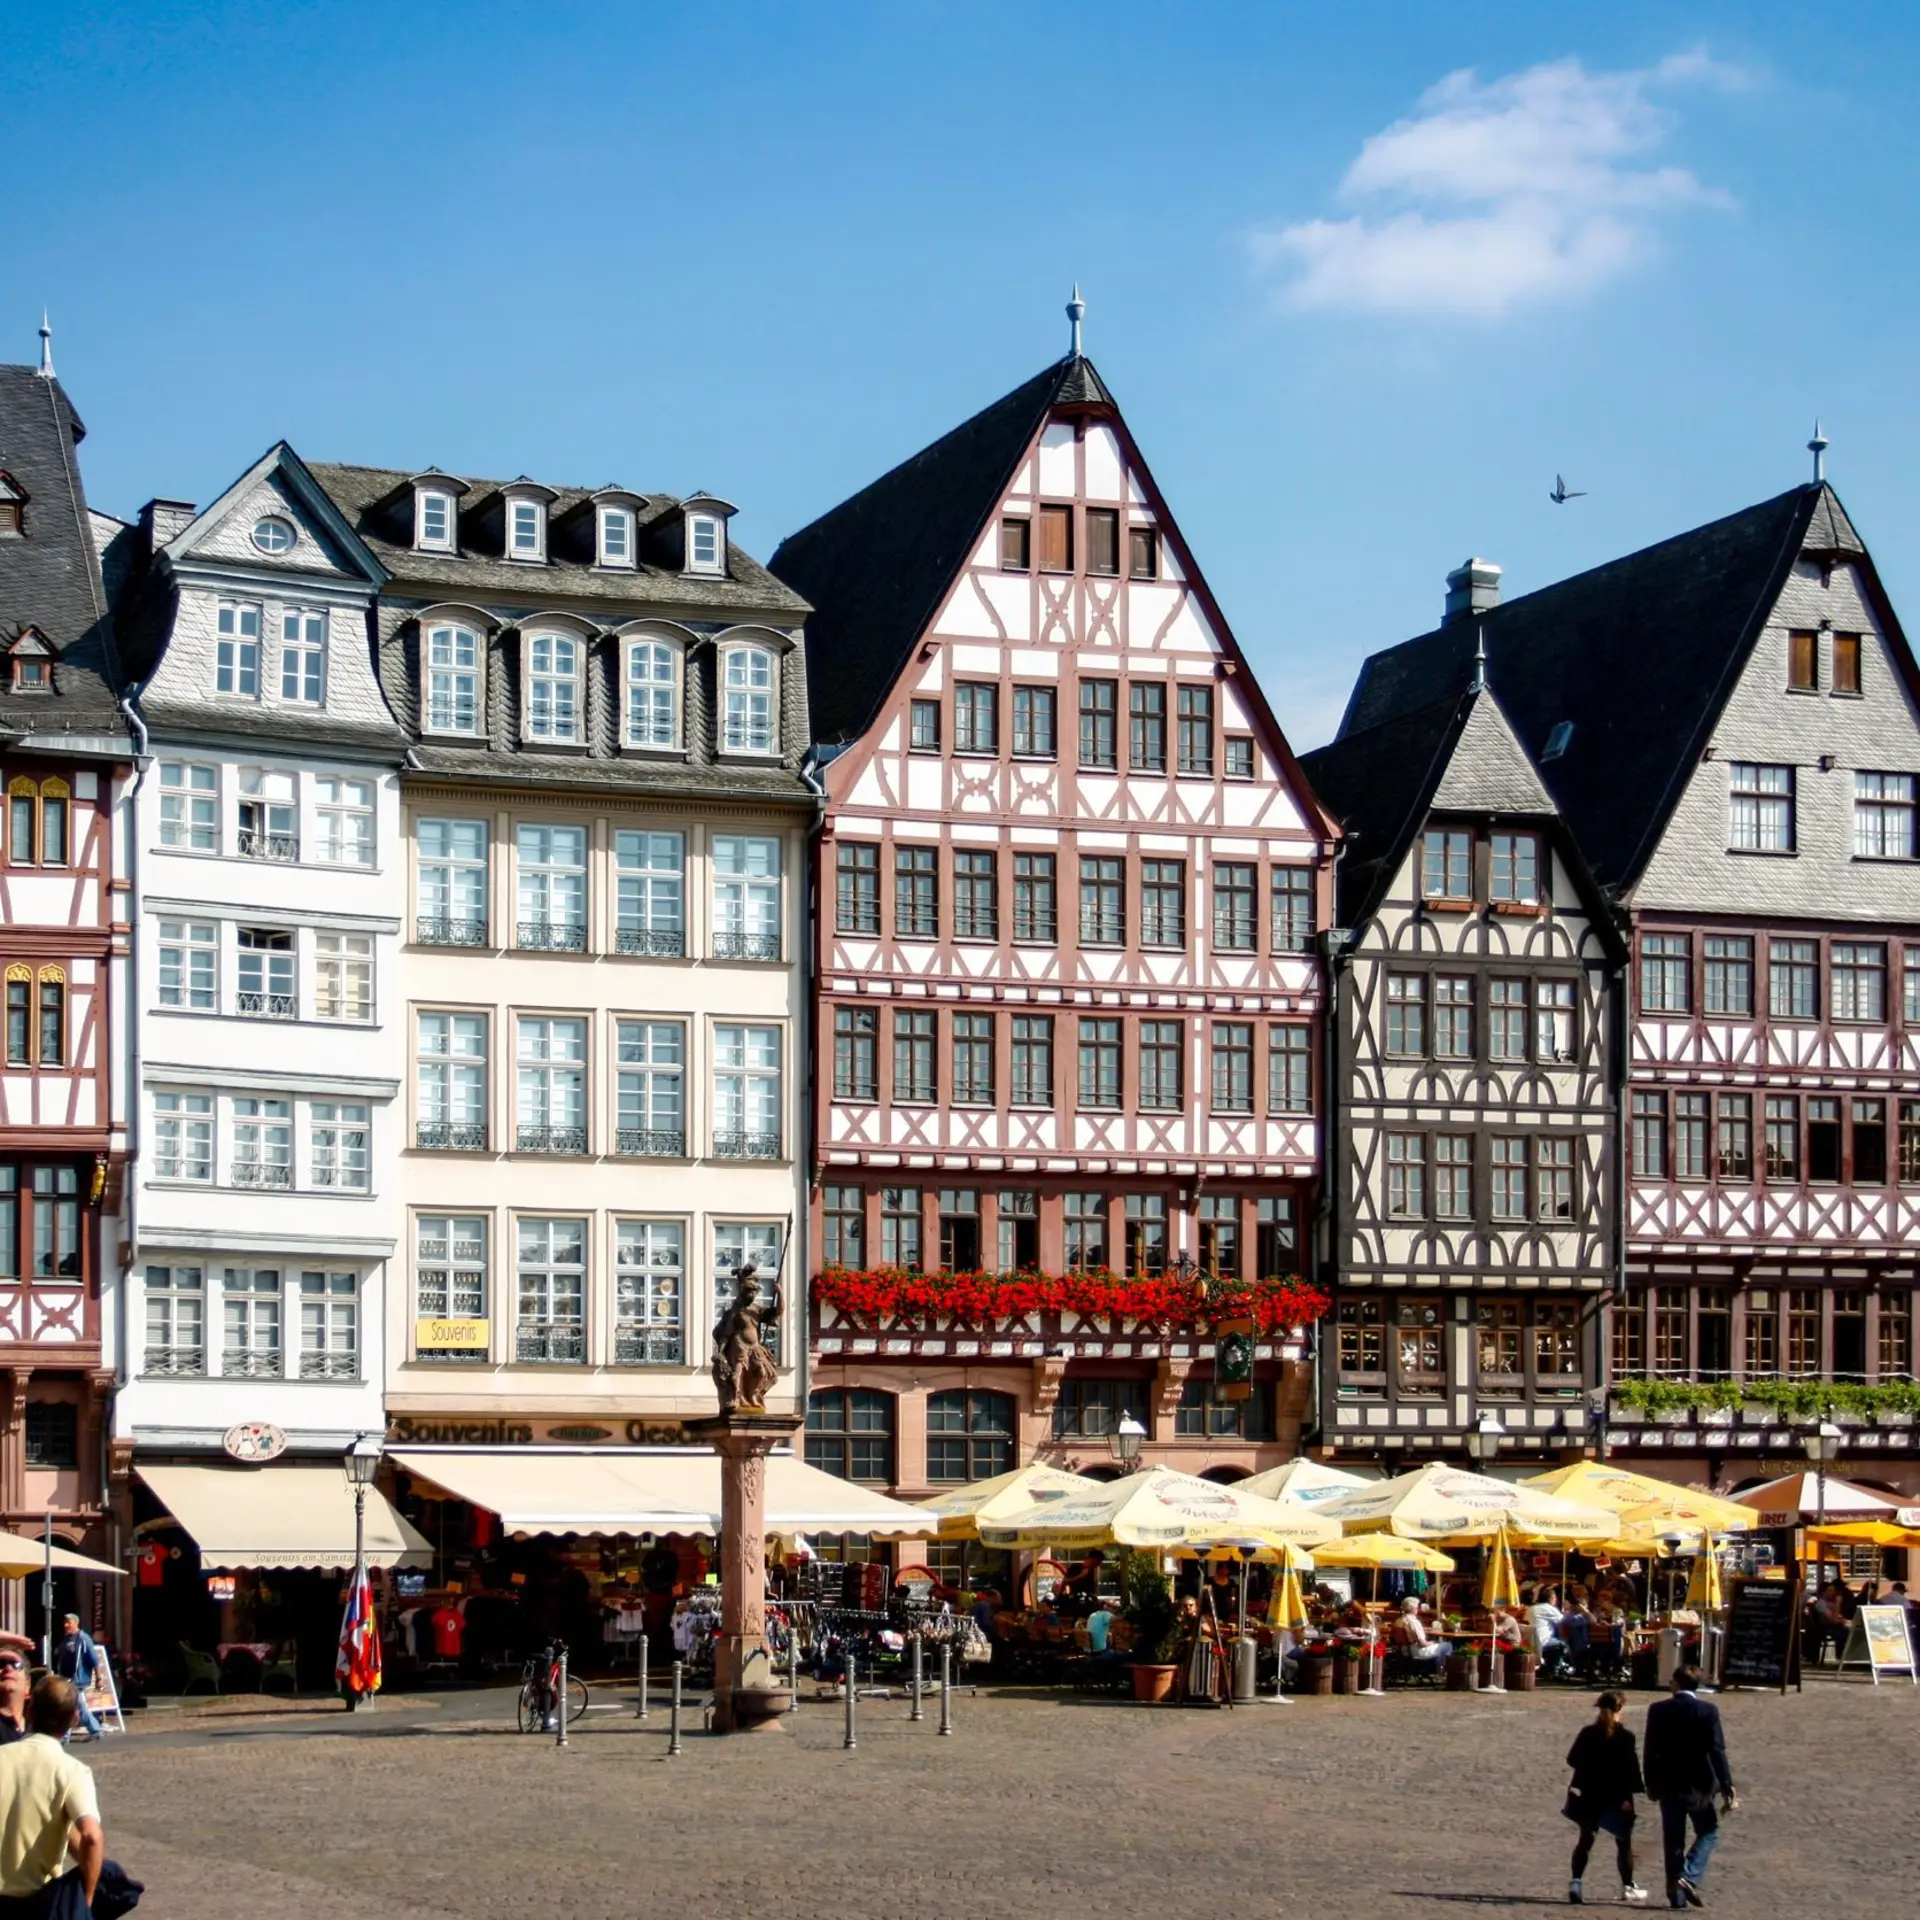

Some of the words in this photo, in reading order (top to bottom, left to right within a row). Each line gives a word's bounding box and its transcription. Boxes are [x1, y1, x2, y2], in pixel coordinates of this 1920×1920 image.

[431, 1321, 477, 1342] Souvenirs
[396, 1418, 533, 1444] Souvenirs
[253, 1552, 300, 1565] Souvenirs
[302, 1555, 317, 1563] am
